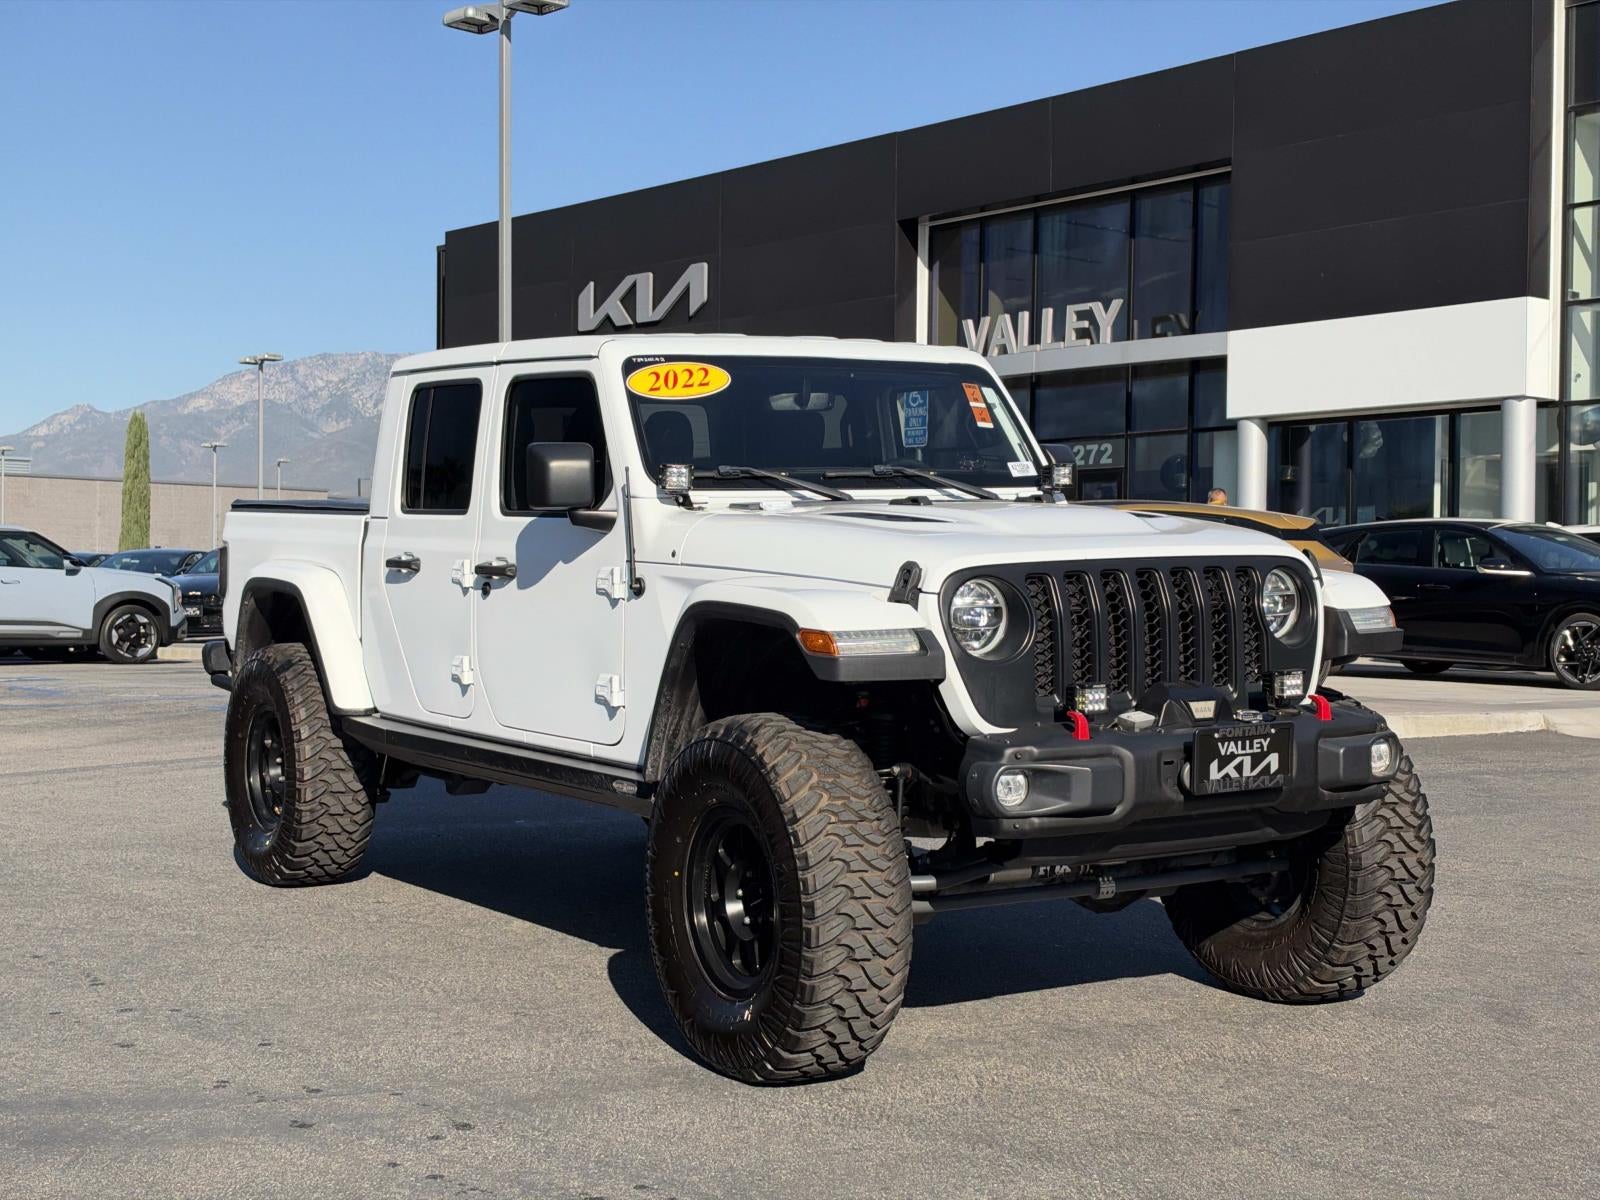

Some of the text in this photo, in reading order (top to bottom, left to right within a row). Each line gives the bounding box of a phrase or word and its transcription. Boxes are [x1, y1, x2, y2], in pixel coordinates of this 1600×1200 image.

[577, 262, 708, 332] KIA
[962, 298, 1124, 357] VALLEY
[648, 367, 711, 392] 2022
[1072, 443, 1113, 466] 272
[1219, 725, 1271, 737] FONTANA
[1218, 738, 1270, 755] VALLEY
[1209, 752, 1279, 779] KIA
